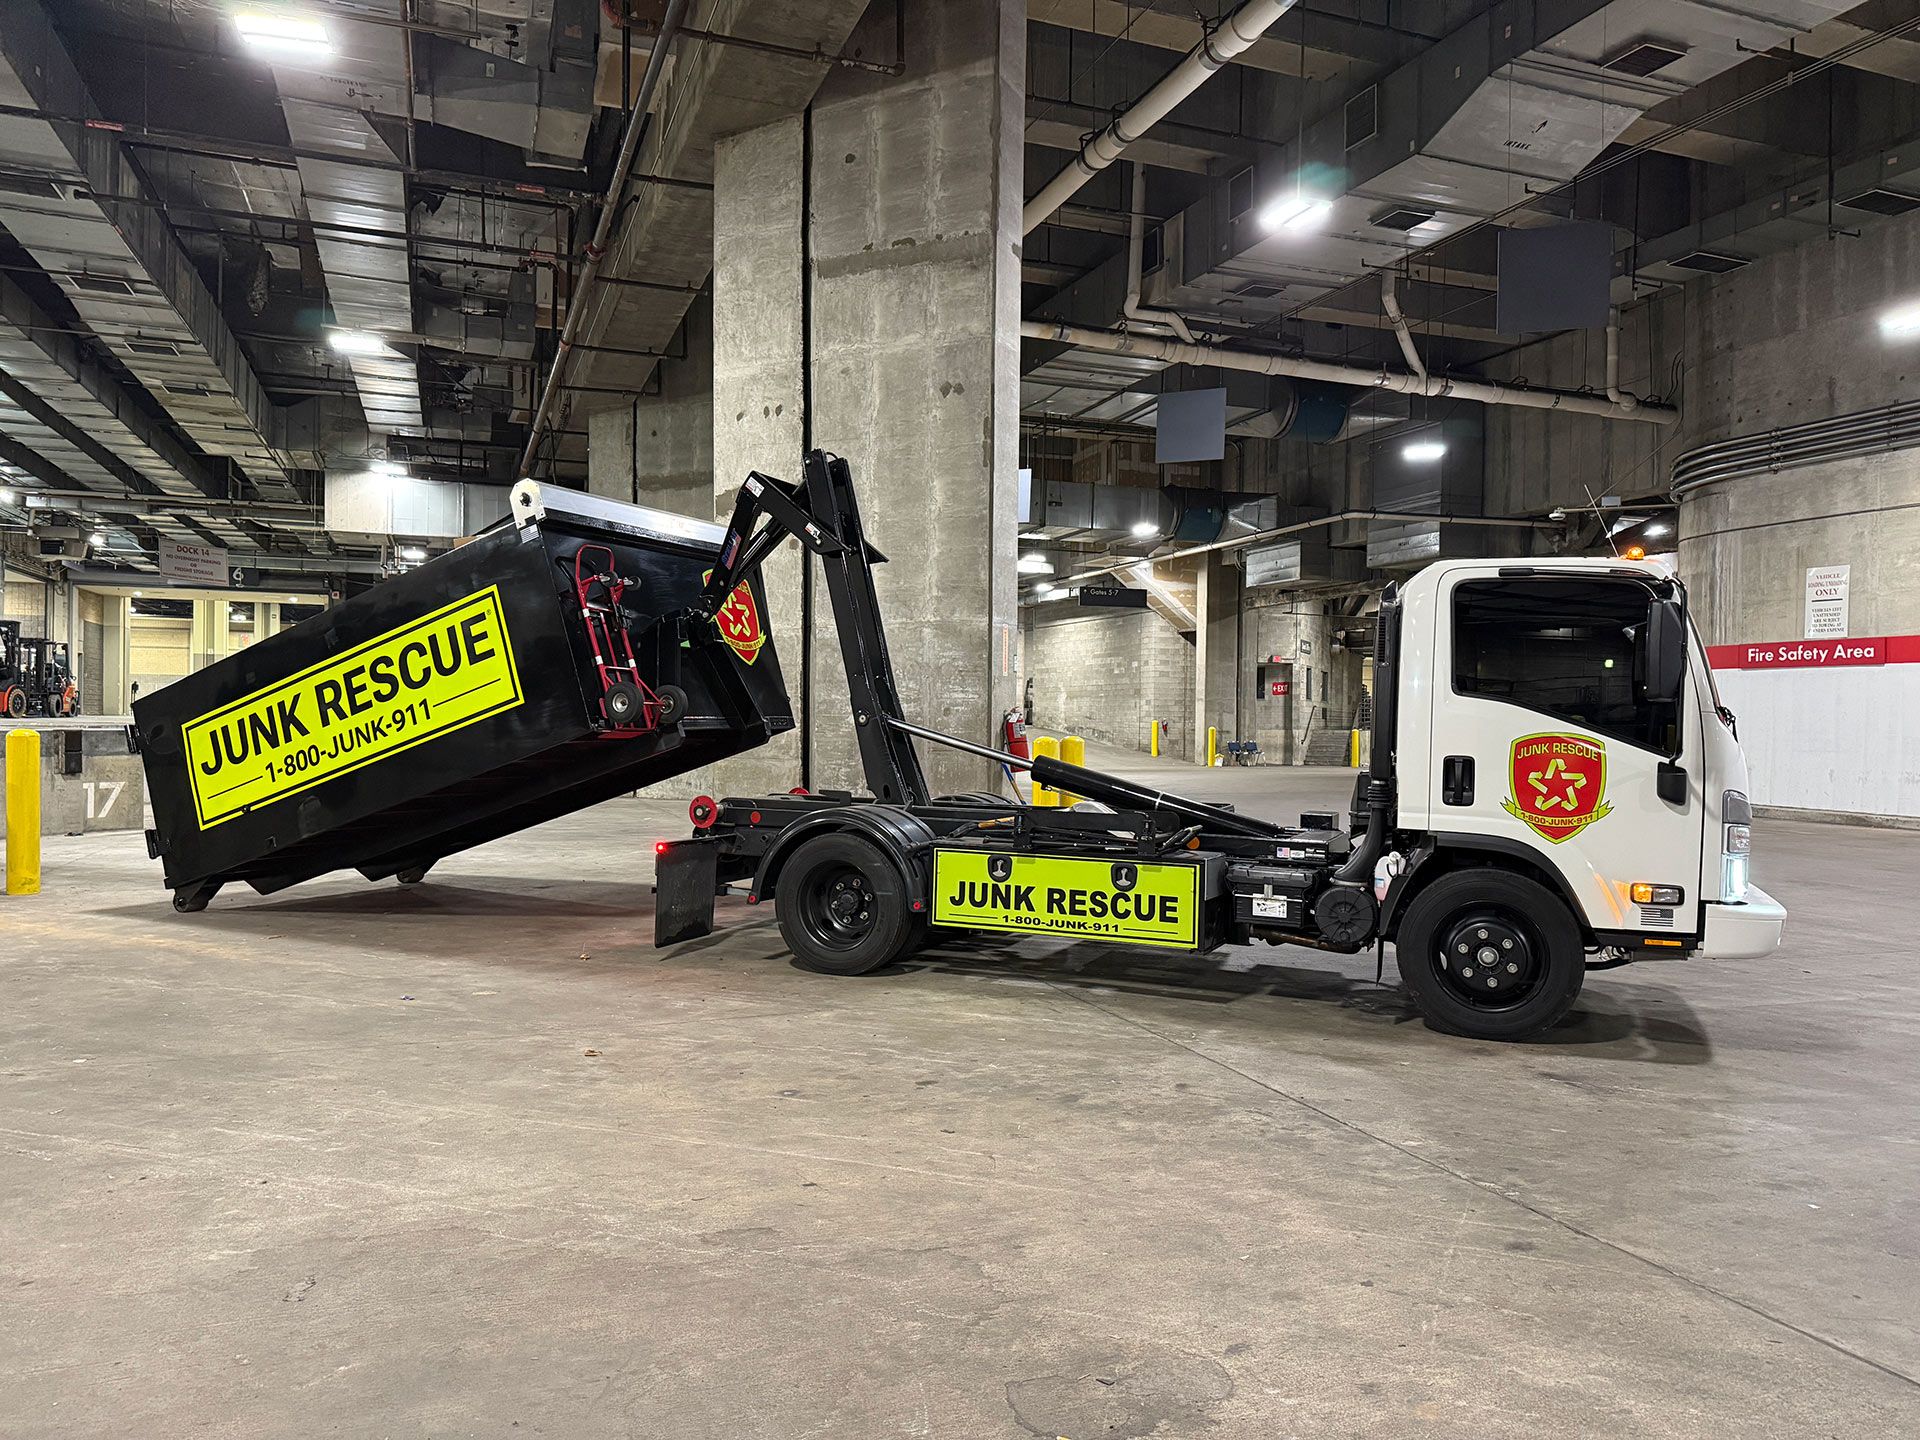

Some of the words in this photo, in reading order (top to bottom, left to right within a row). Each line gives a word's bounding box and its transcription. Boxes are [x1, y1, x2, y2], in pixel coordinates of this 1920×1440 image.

[174, 555, 200, 563] OVERNIGHT
[200, 558, 222, 566] PARKING
[176, 545, 199, 556] DOCK
[201, 548, 210, 557] 14
[1815, 587, 1840, 597] ONLY
[1747, 648, 1774, 662] Fire
[1778, 645, 1828, 662] Safety
[1833, 644, 1875, 659] Area
[201, 692, 310, 776] JUNK
[314, 612, 496, 728] RESCUE
[265, 698, 431, 783] 1-800-JUNK-911
[1517, 742, 1550, 760] JUNK
[1552, 742, 1600, 761] RESCUE
[82, 781, 126, 819] 17
[1520, 811, 1594, 826] 1-800-JUNK-911
[949, 880, 1036, 912] JUNK
[1046, 887, 1179, 924] RESCUE
[1001, 914, 1120, 933] 1-800-JUNK-911
